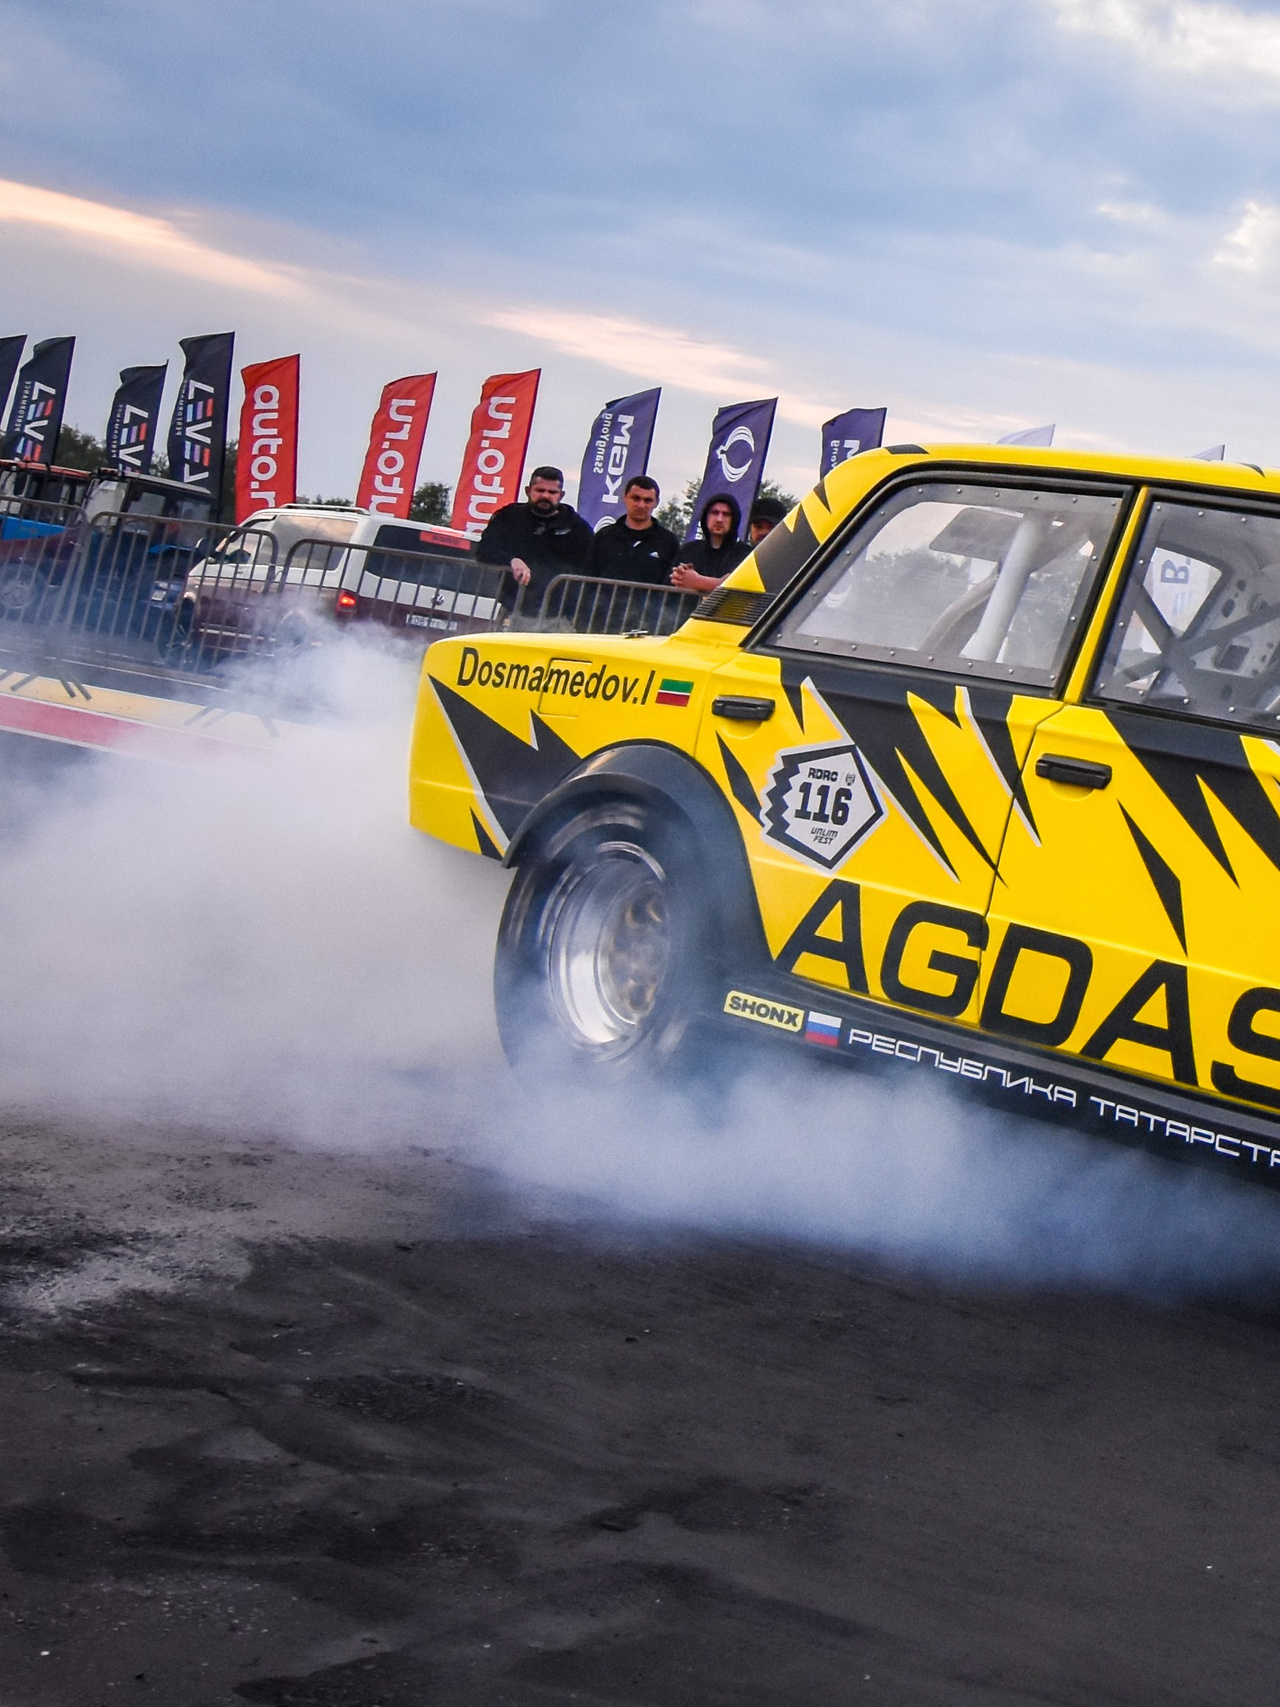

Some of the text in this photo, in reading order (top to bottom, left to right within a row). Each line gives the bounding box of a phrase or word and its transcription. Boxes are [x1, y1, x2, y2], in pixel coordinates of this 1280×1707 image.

[808, 767, 839, 782] RDRC
[794, 781, 853, 826] 116
[813, 835, 833, 845] FEST
[729, 995, 799, 1027] SHONX
[848, 1027, 1077, 1108] РЕСПУБЛИКА
